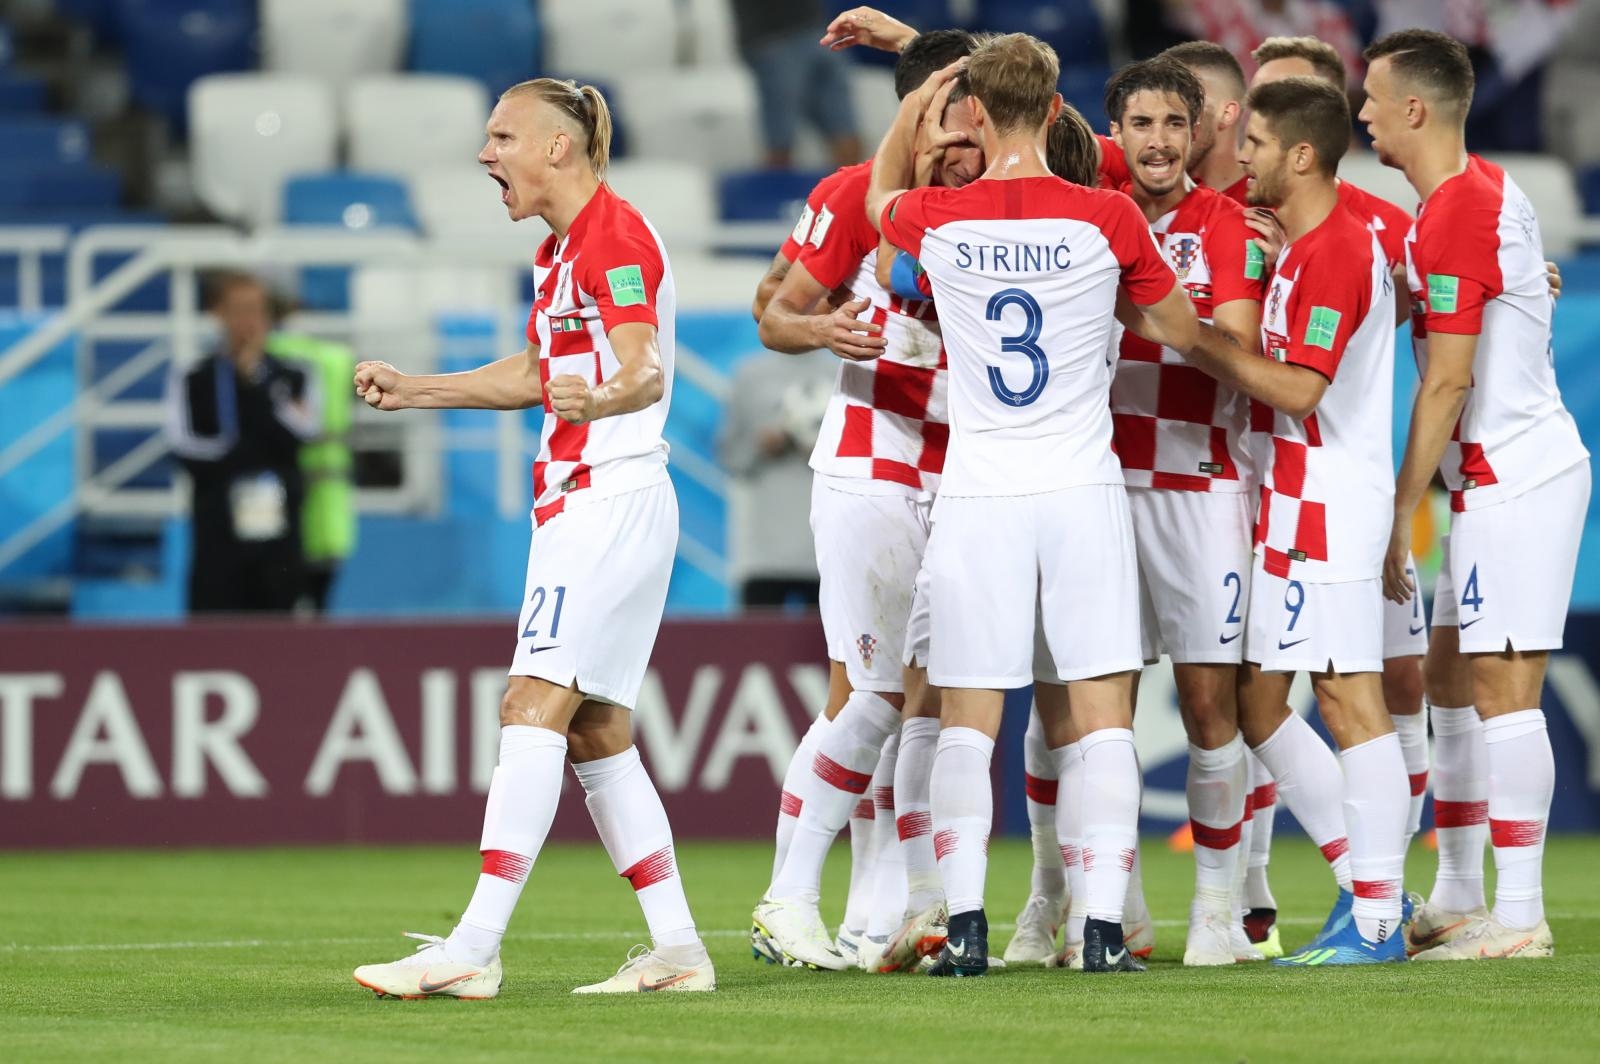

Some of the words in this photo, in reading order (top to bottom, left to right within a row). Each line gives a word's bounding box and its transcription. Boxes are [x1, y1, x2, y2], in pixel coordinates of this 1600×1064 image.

[956, 237, 1071, 272] STRINIĆ
[985, 287, 1050, 407] 3
[521, 586, 567, 639] 21
[1223, 571, 1242, 624] 2
[1284, 579, 1305, 632] 9
[1460, 560, 1484, 612] 4
